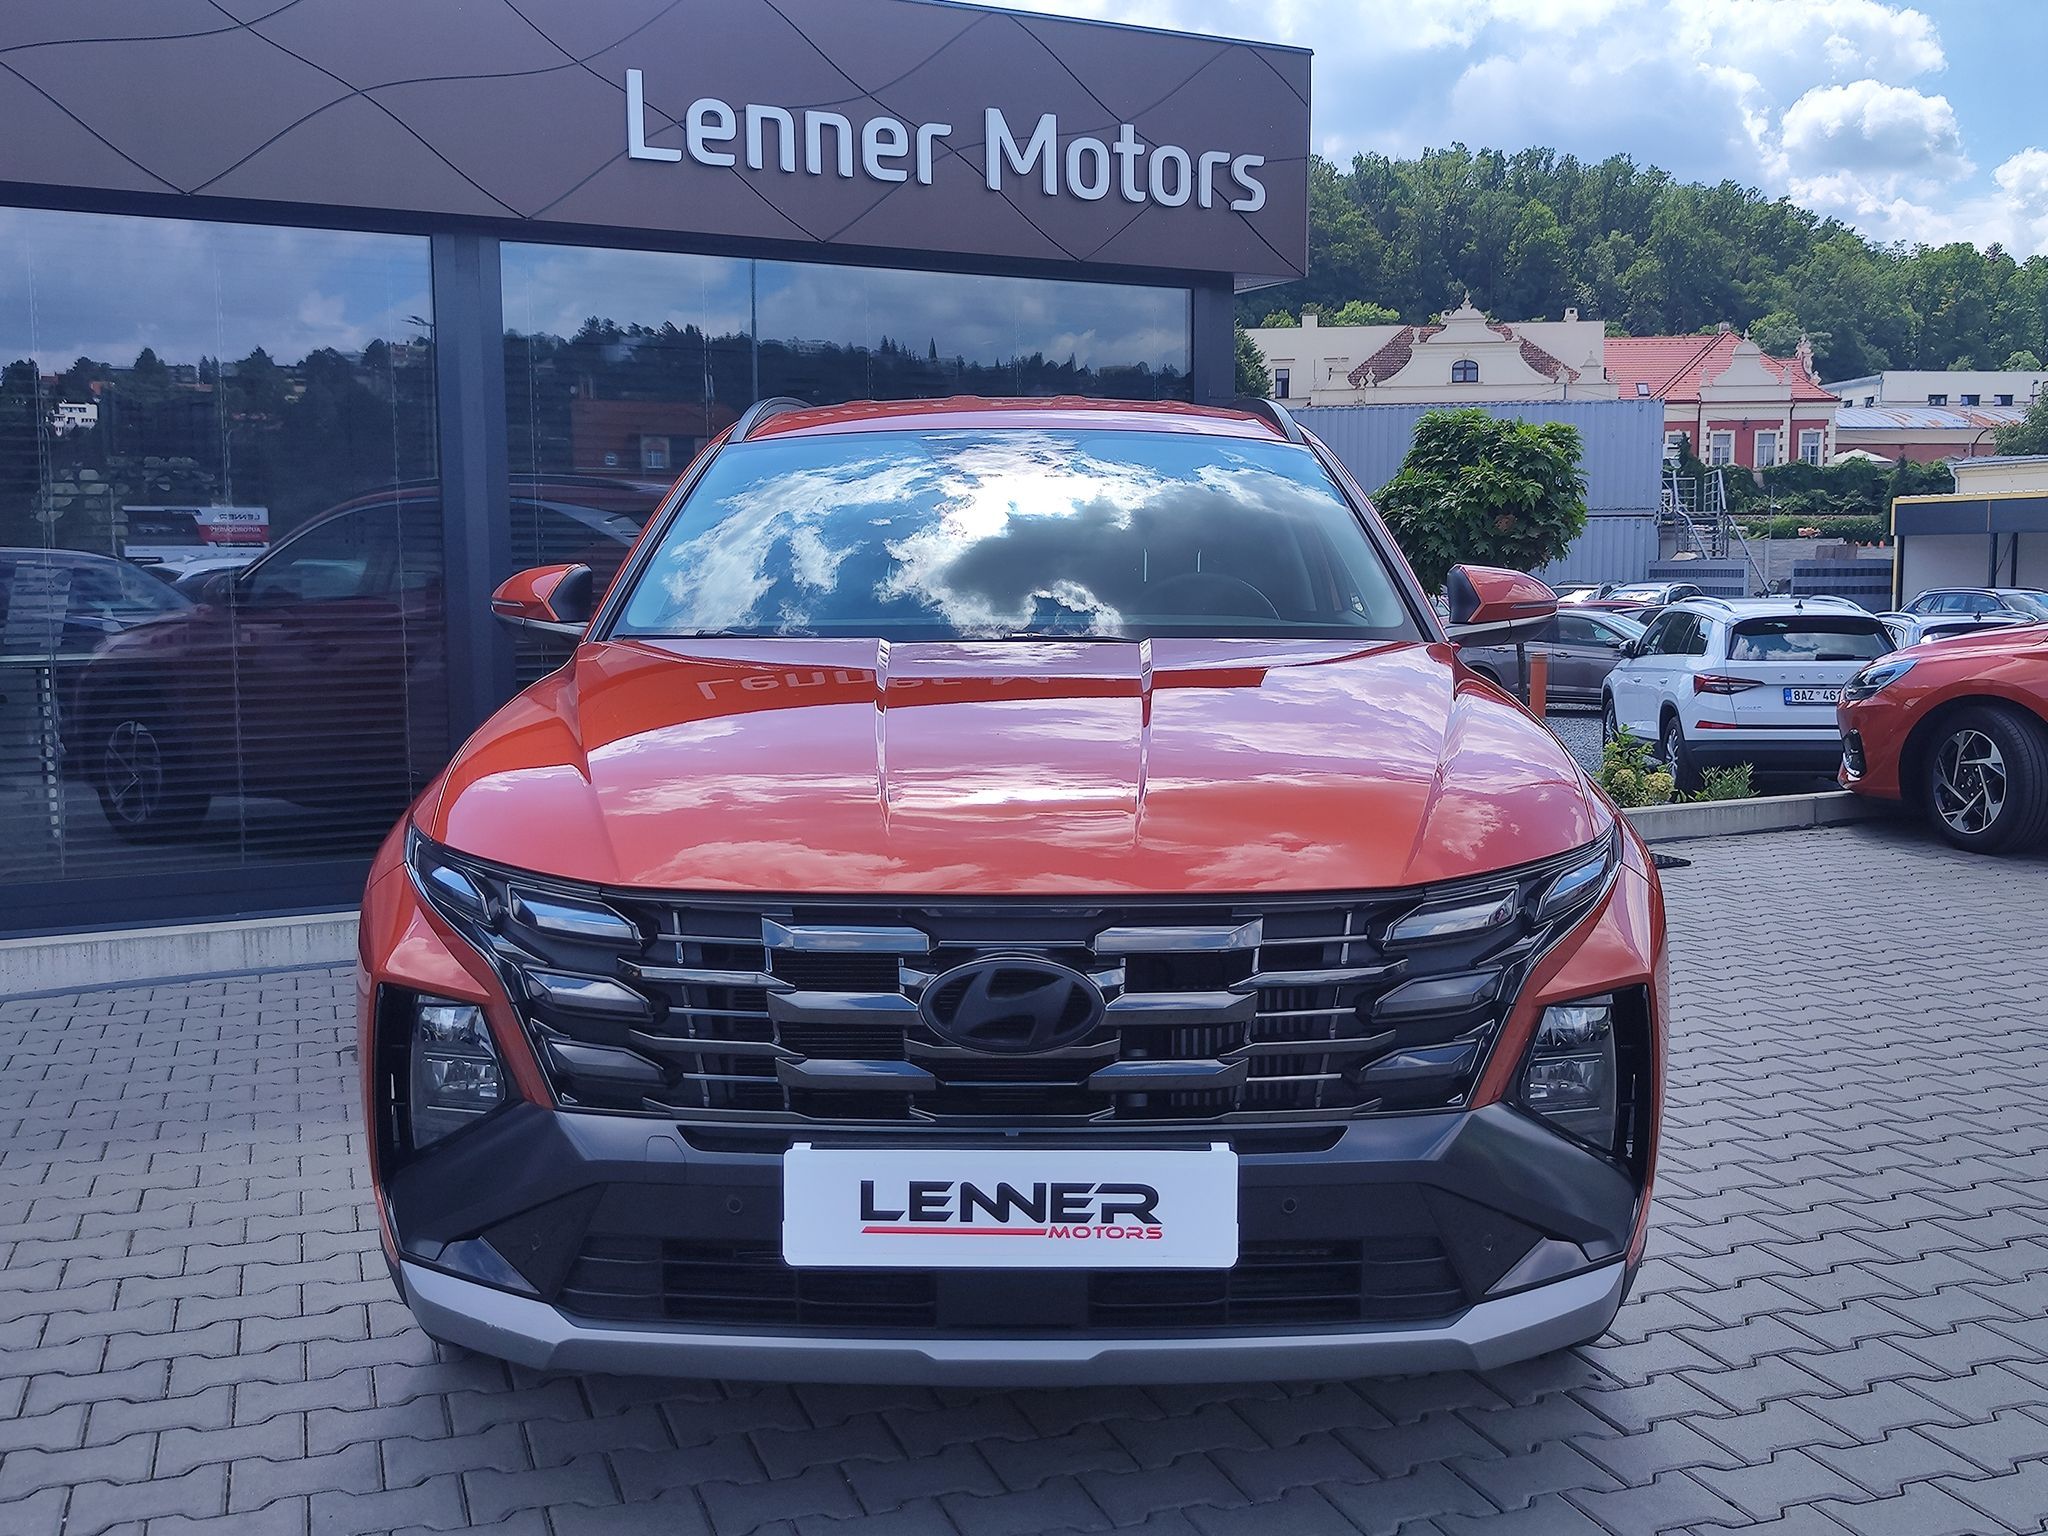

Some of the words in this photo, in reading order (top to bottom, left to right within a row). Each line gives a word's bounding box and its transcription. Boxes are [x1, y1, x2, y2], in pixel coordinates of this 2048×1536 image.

[626, 68, 952, 185] Lenner
[984, 107, 1267, 212] Motors
[1793, 690, 1814, 701] 8AZ
[860, 1180, 1162, 1224] LENNER
[1048, 1225, 1163, 1240] MOTORS
